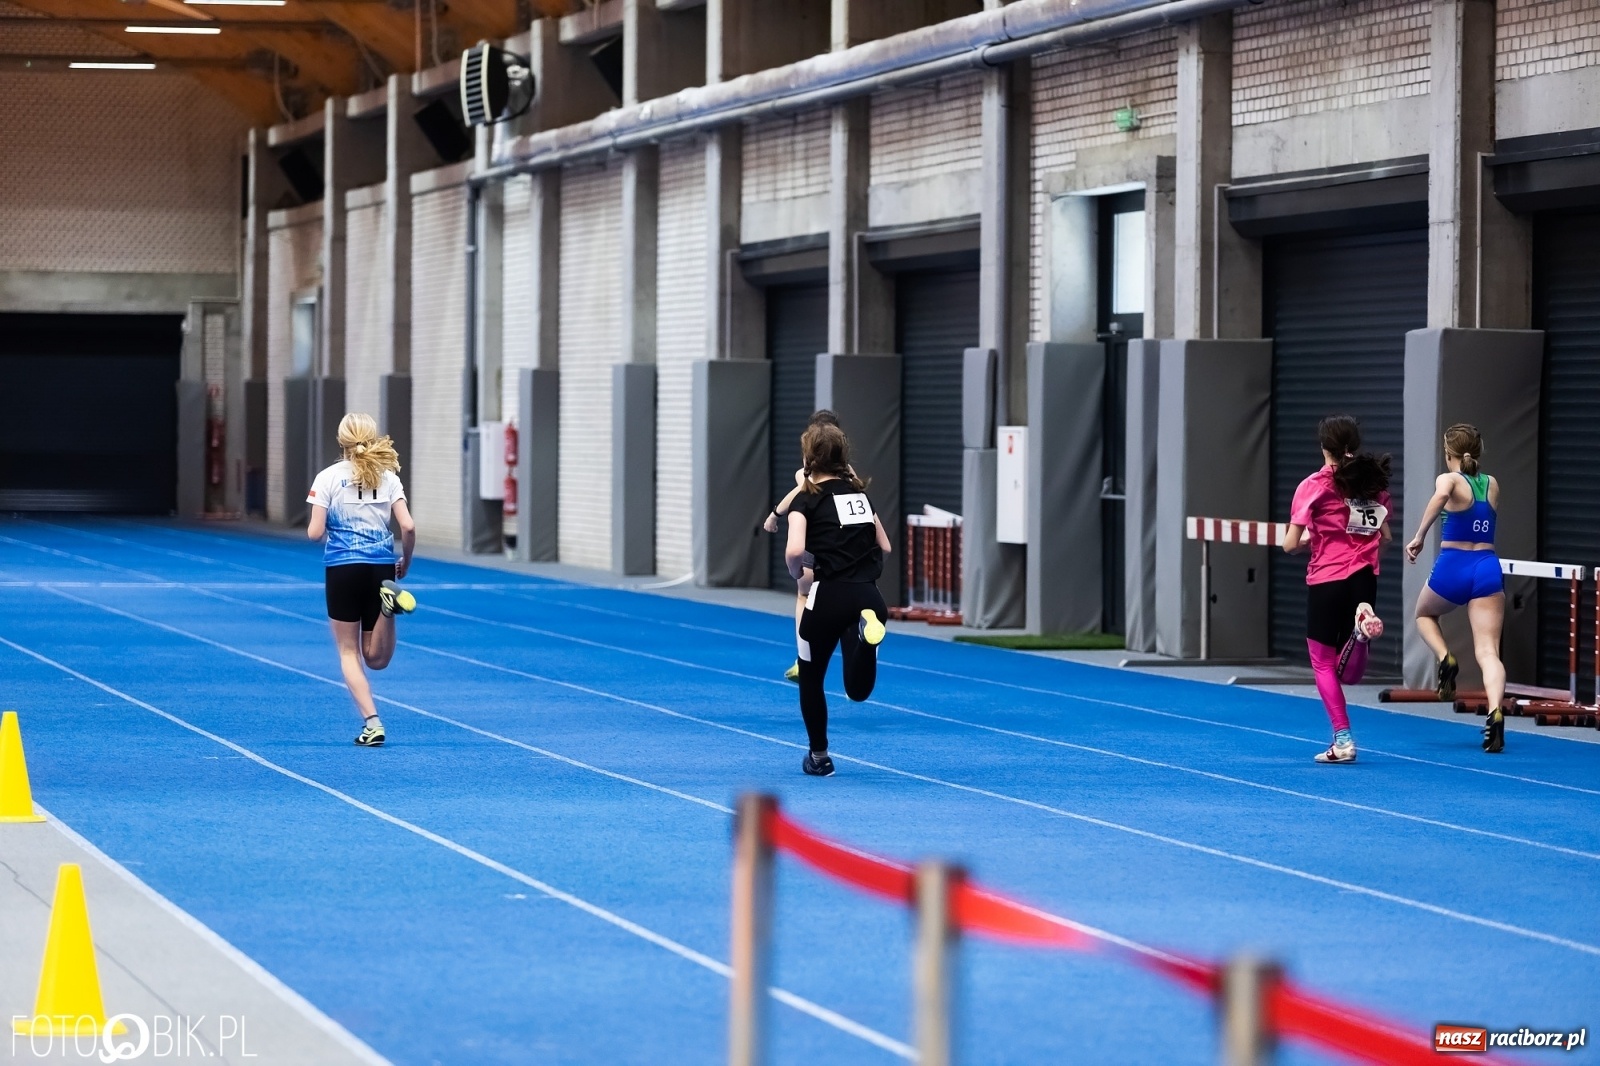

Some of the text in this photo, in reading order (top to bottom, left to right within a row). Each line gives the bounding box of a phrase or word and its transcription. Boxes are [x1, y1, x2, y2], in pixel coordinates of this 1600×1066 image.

[846, 499, 866, 516] 13
[1356, 509, 1378, 527] 75
[1472, 519, 1490, 533] 68
